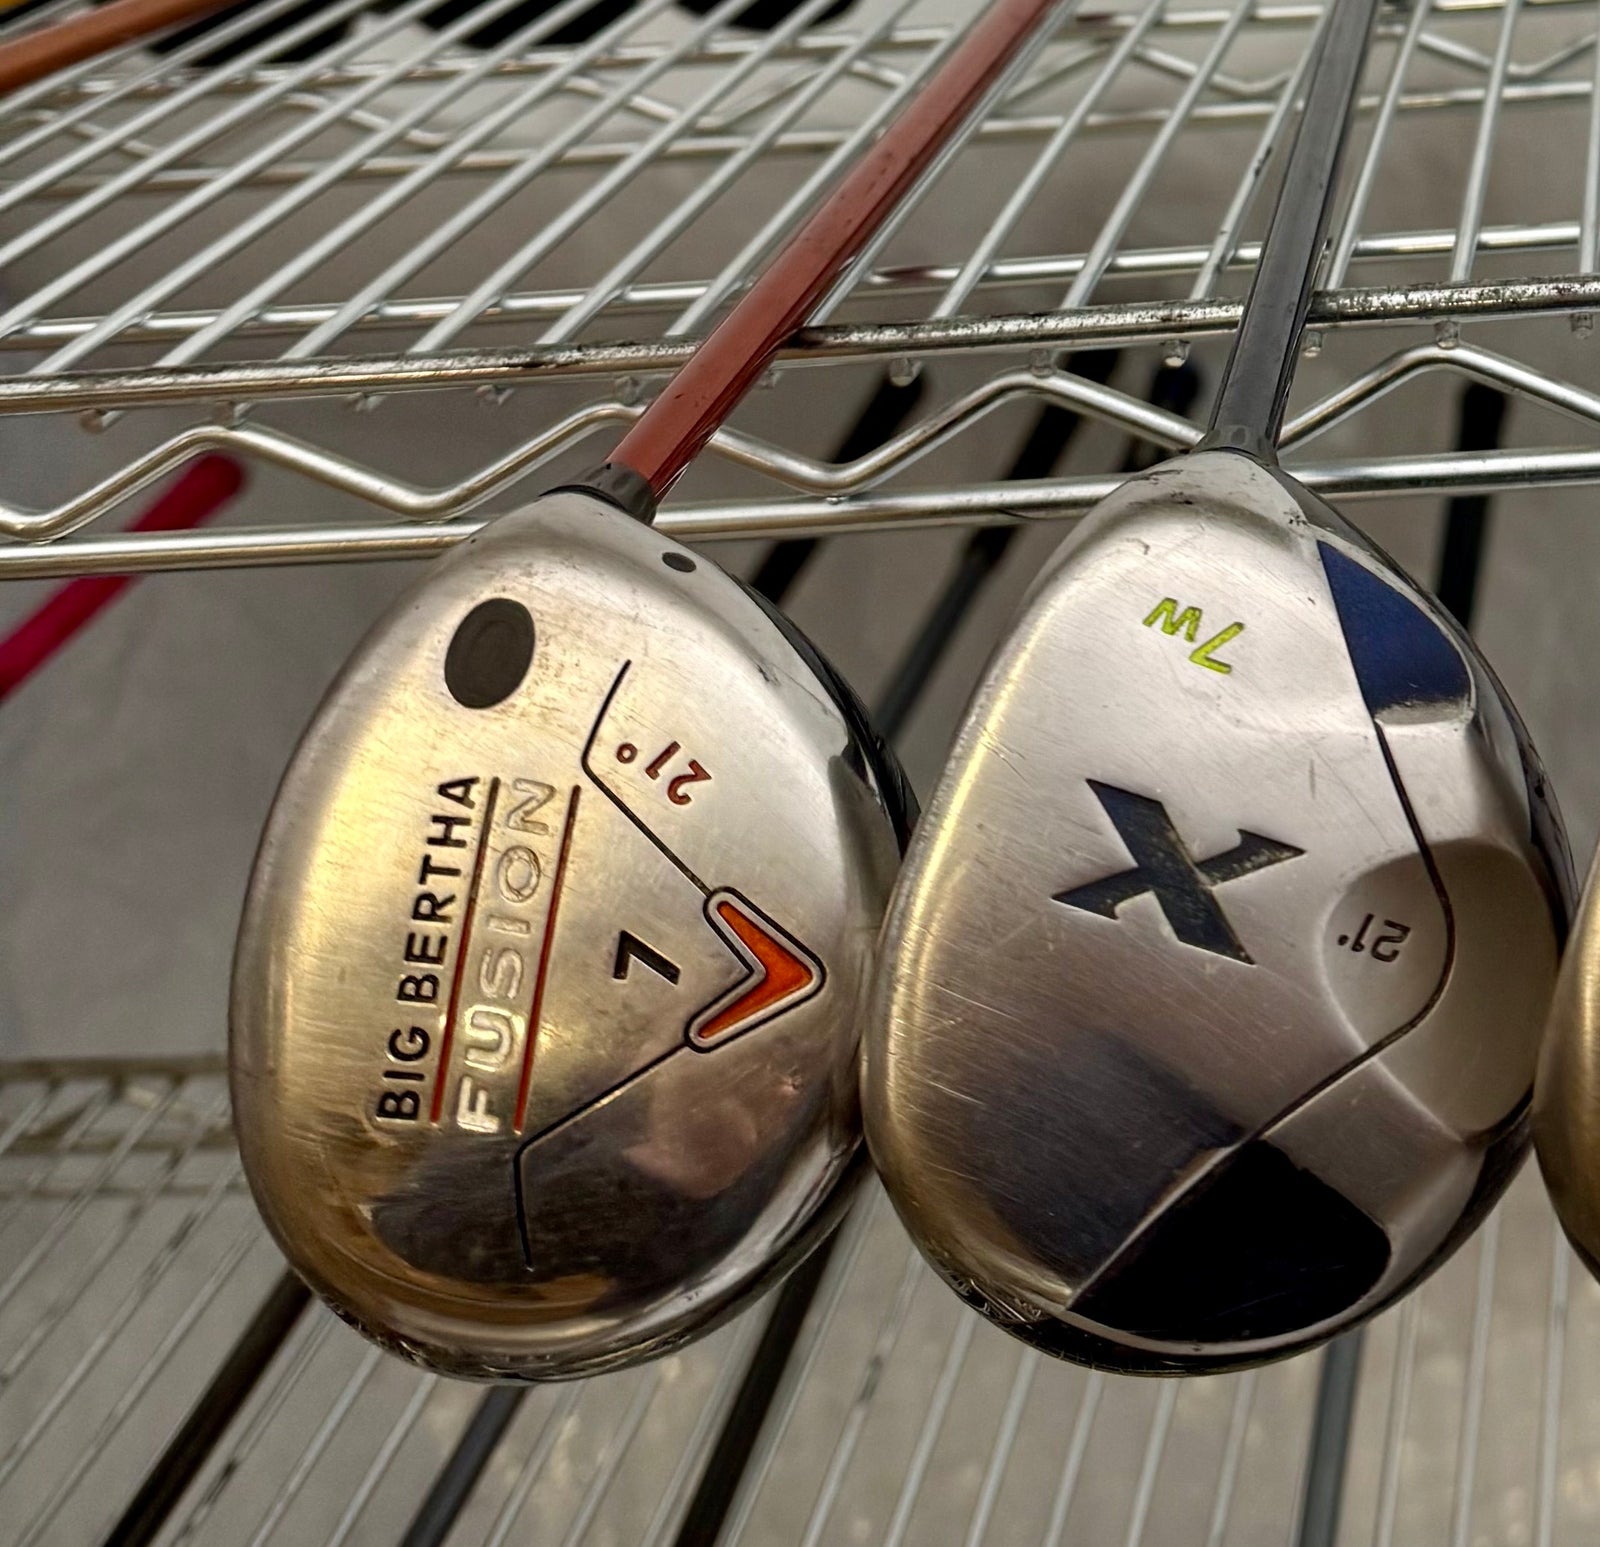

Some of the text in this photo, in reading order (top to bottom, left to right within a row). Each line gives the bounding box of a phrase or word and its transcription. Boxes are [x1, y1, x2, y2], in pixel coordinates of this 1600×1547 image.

[376, 775, 479, 1122] BIG BERTHA
[457, 777, 558, 1133] FUSION
[613, 929, 681, 987] 7
